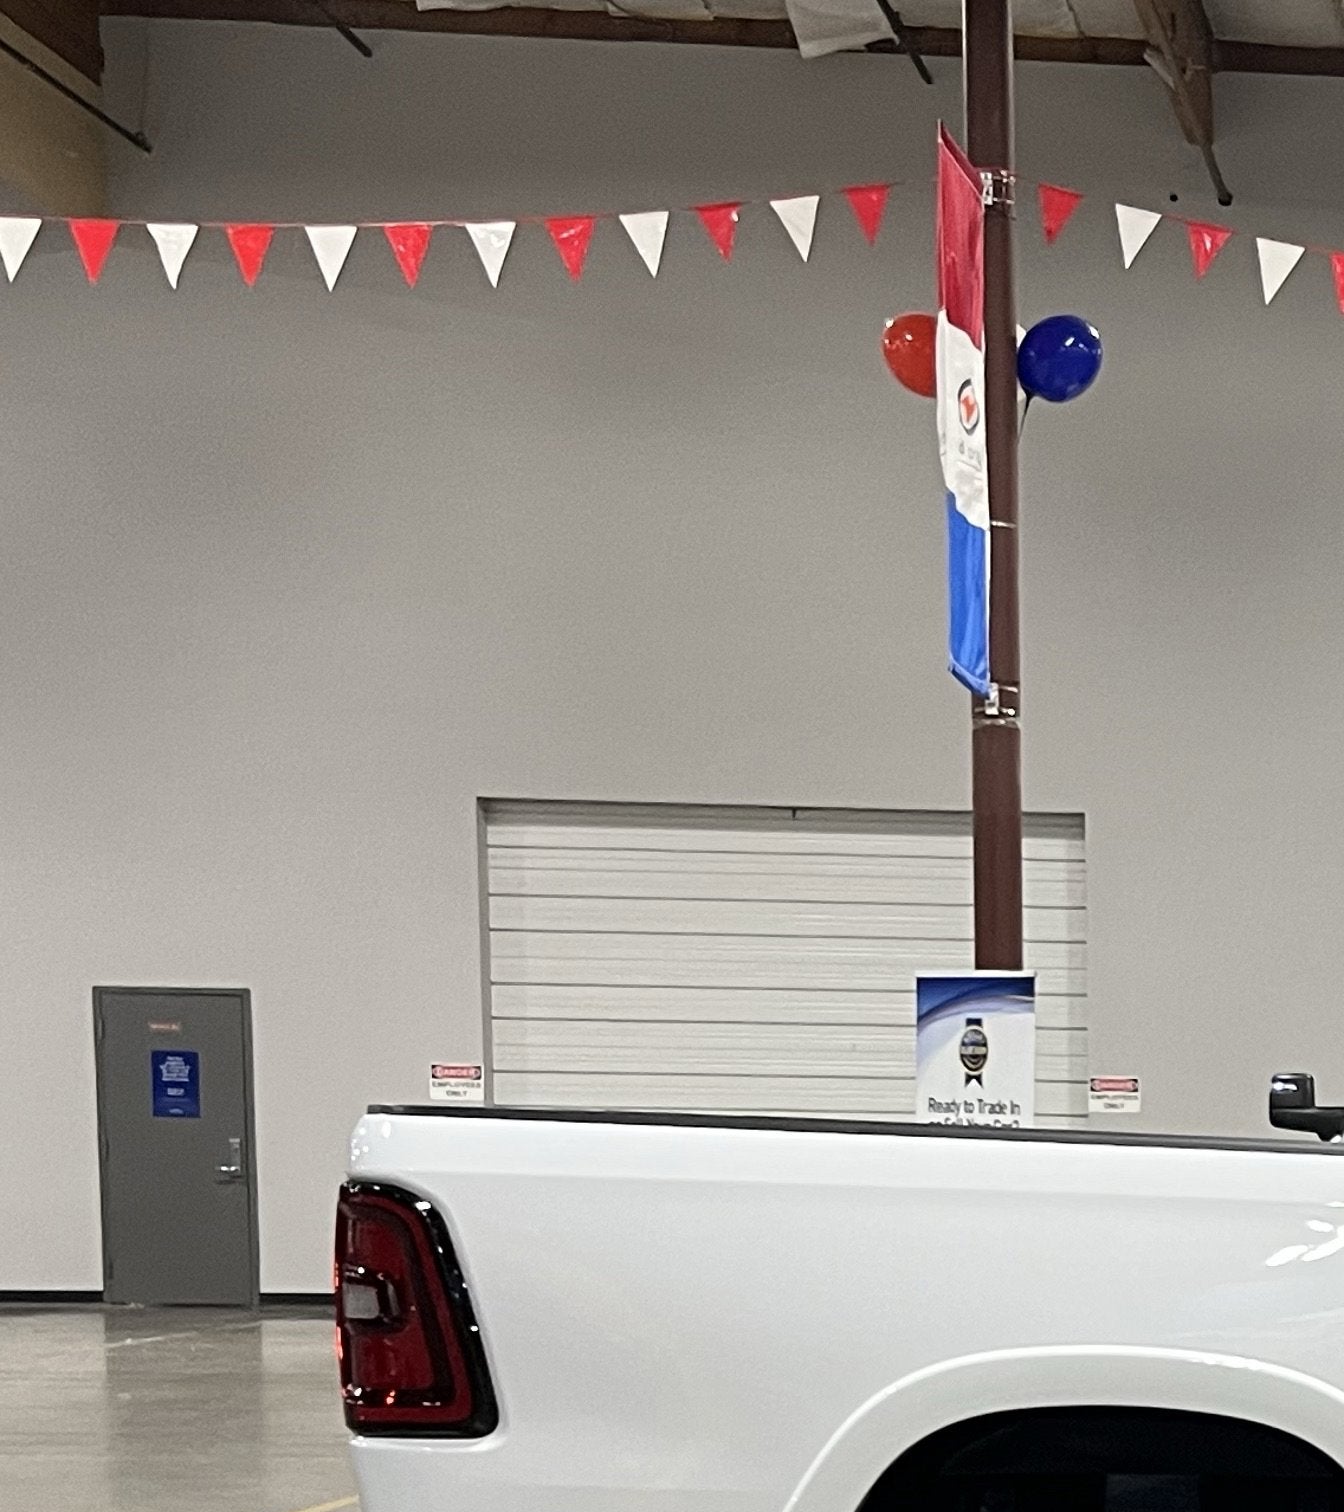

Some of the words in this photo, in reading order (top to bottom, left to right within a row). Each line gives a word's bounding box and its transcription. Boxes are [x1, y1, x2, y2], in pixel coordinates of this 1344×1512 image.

[927, 1096, 961, 1118] Ready
[963, 1099, 975, 1114] to
[977, 1098, 1008, 1115] Trade
